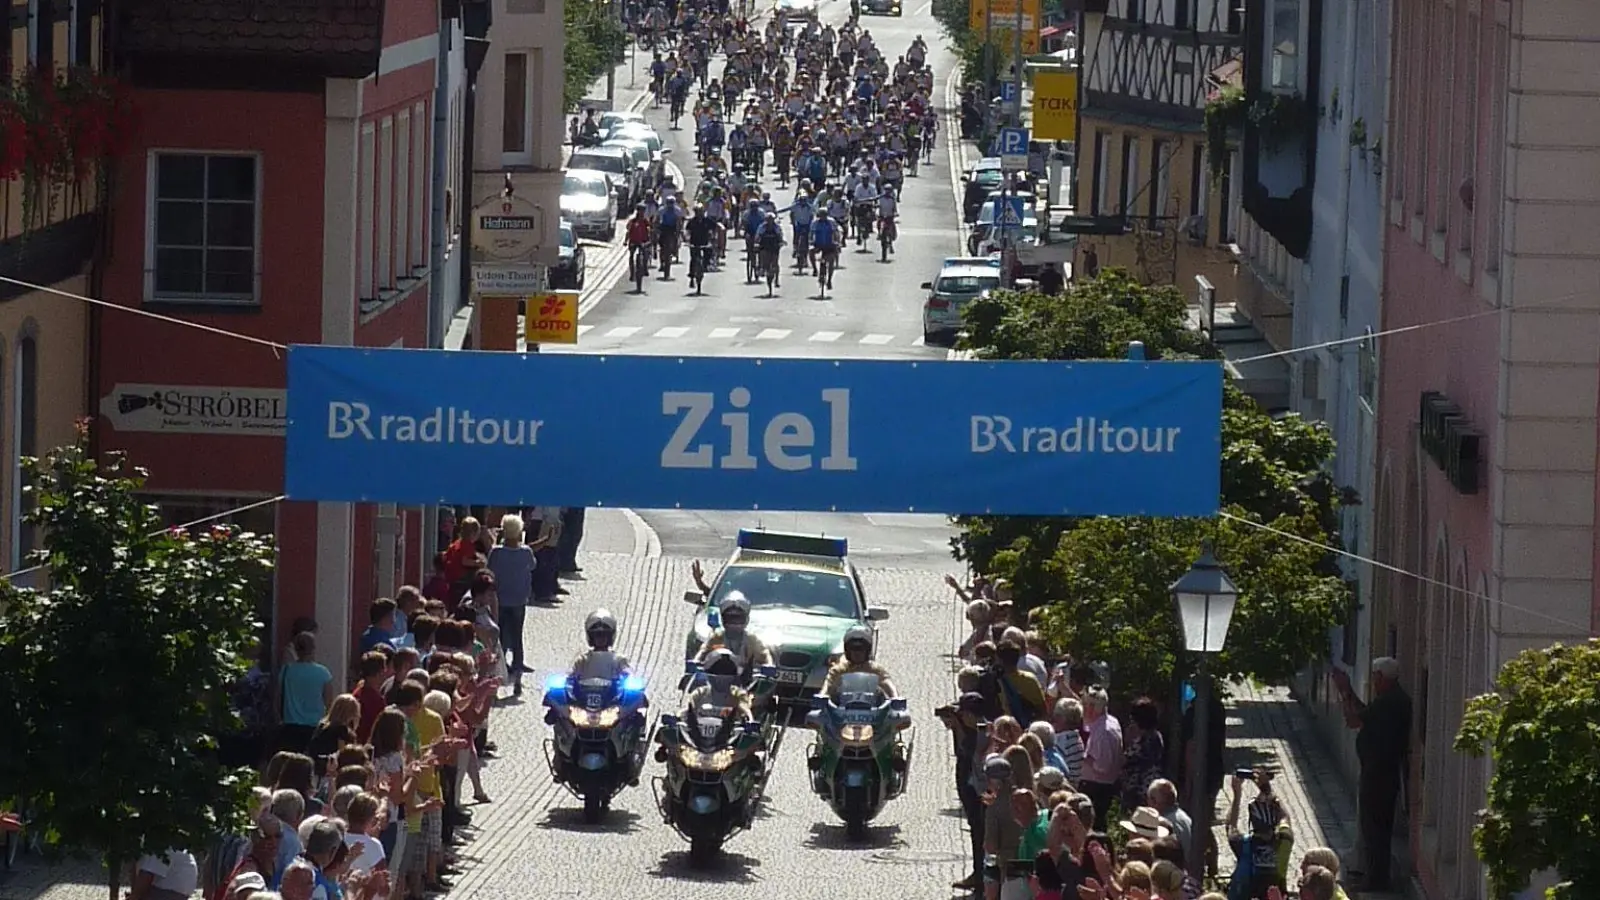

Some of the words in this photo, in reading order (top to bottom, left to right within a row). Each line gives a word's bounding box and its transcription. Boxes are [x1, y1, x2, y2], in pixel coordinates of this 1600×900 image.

[1006, 131, 1020, 152] P
[532, 320, 571, 330] LOTTO
[163, 391, 287, 419] STRÖBEL
[380, 406, 544, 445] radltour
[661, 387, 857, 471] Ziel
[1022, 416, 1181, 453] radltour
